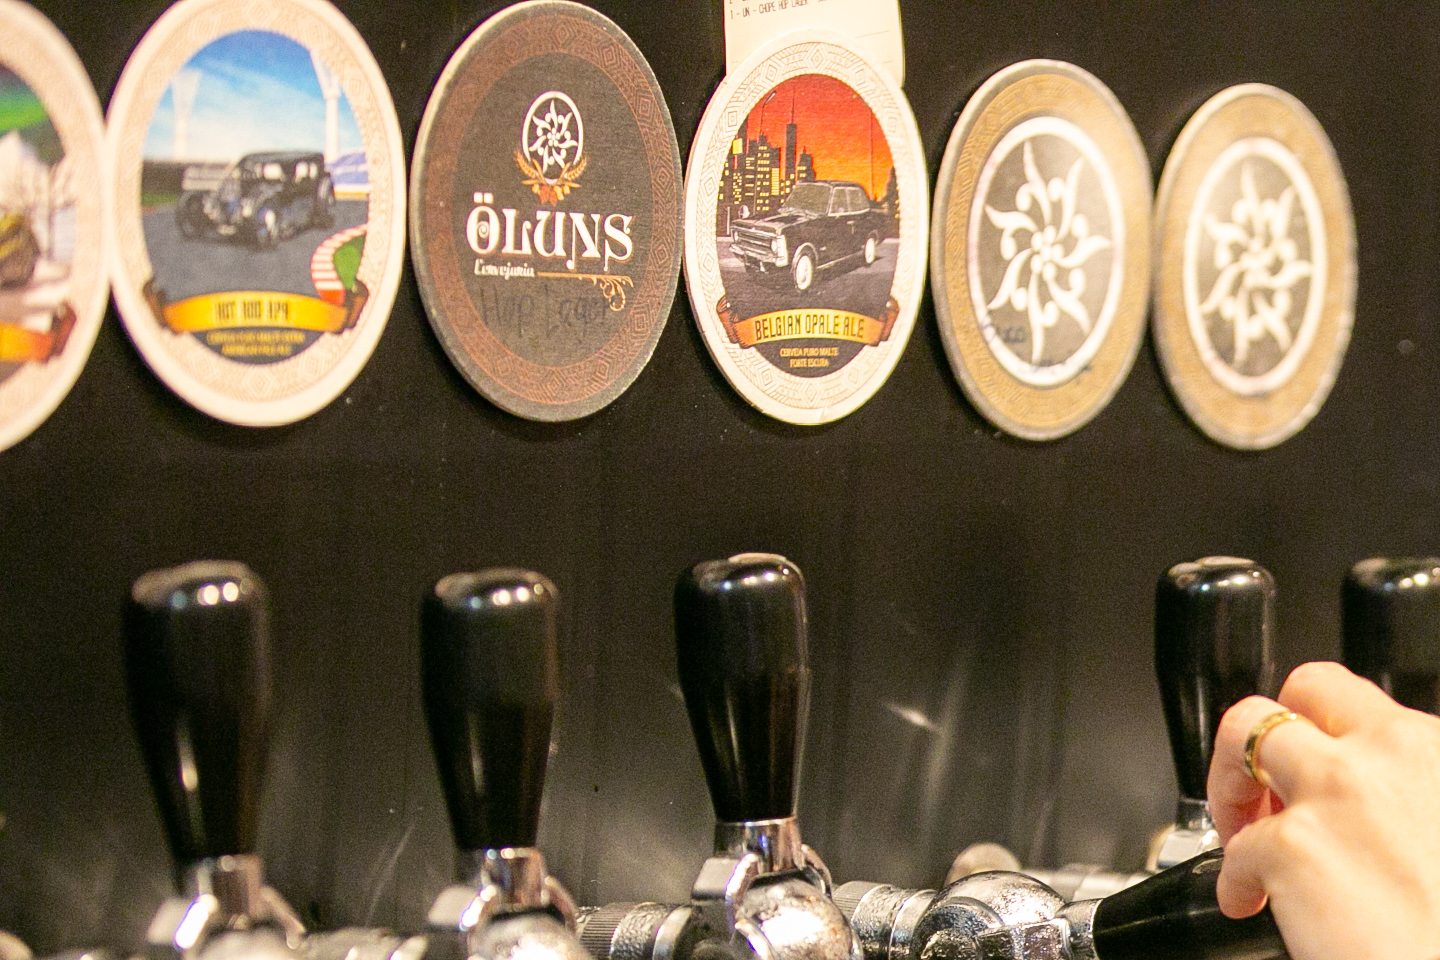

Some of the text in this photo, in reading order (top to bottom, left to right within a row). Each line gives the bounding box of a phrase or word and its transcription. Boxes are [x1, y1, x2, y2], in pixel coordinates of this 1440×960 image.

[759, 1, 776, 13] CHOPE
[473, 257, 536, 280] Cervejaria
[755, 314, 865, 340] BELGIAN OPALE ALE
[803, 347, 819, 357] PURO
[819, 346, 839, 357] MALTE
[789, 358, 829, 368] FORTE ESCURA
